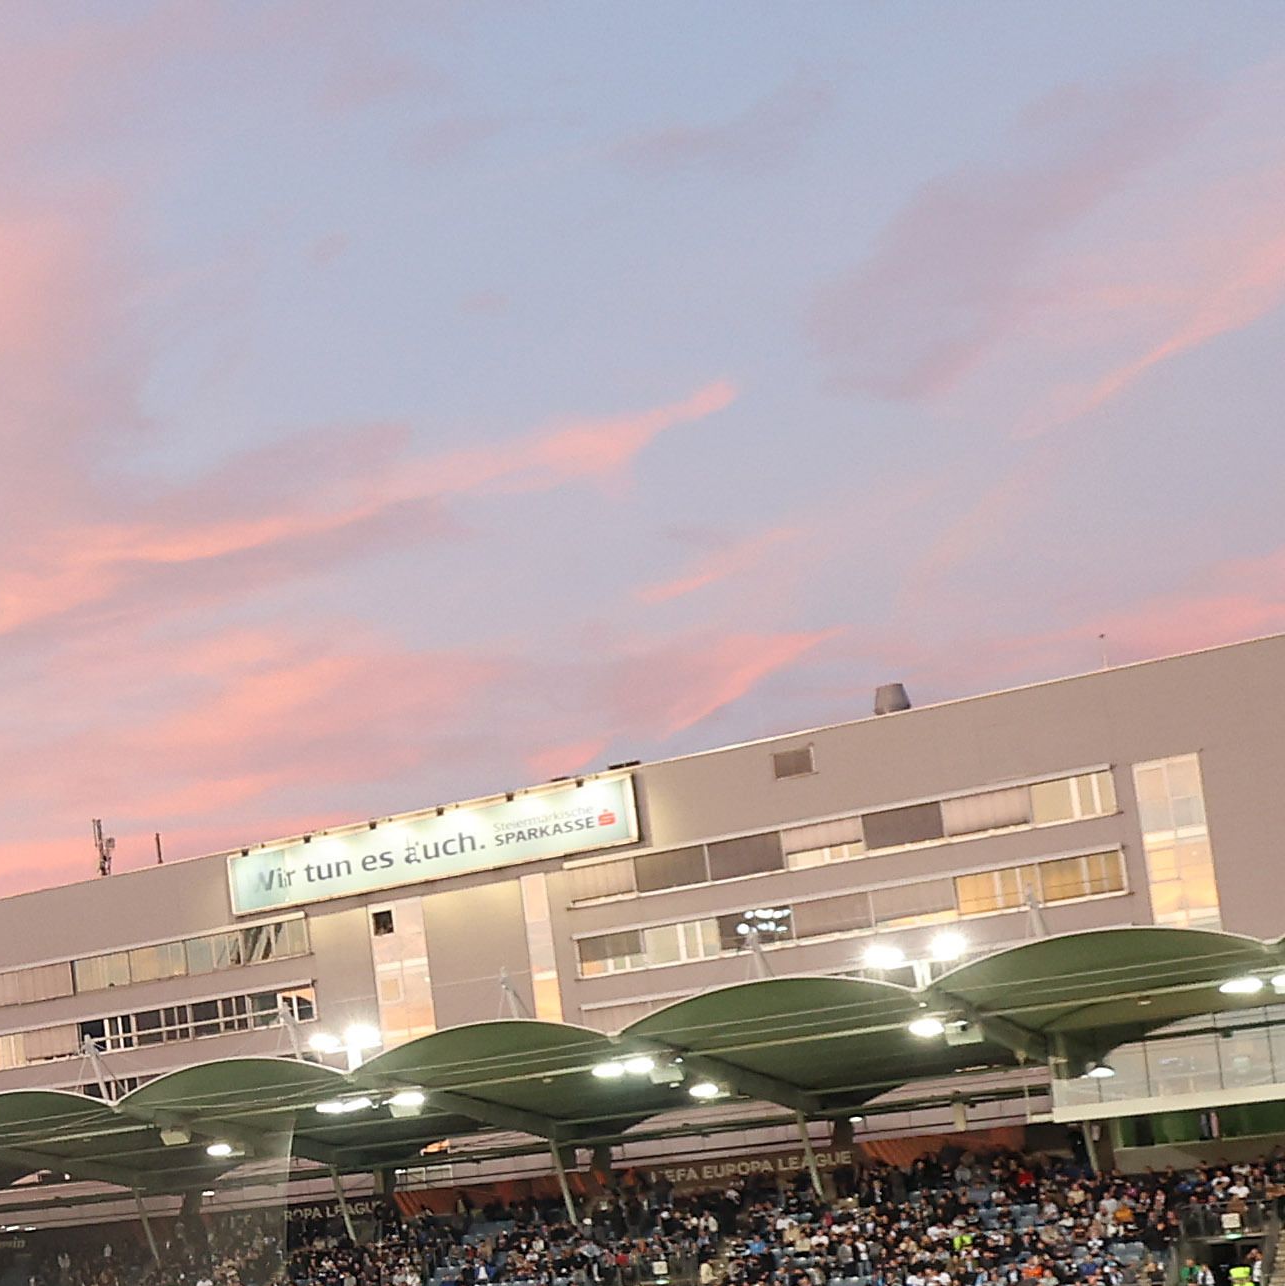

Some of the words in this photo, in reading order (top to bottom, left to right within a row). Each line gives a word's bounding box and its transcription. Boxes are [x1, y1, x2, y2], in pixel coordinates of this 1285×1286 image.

[494, 816, 595, 847] SPARKASSE
[305, 858, 352, 883] tun
[361, 850, 394, 872] es
[701, 1159, 774, 1179] EUROPA
